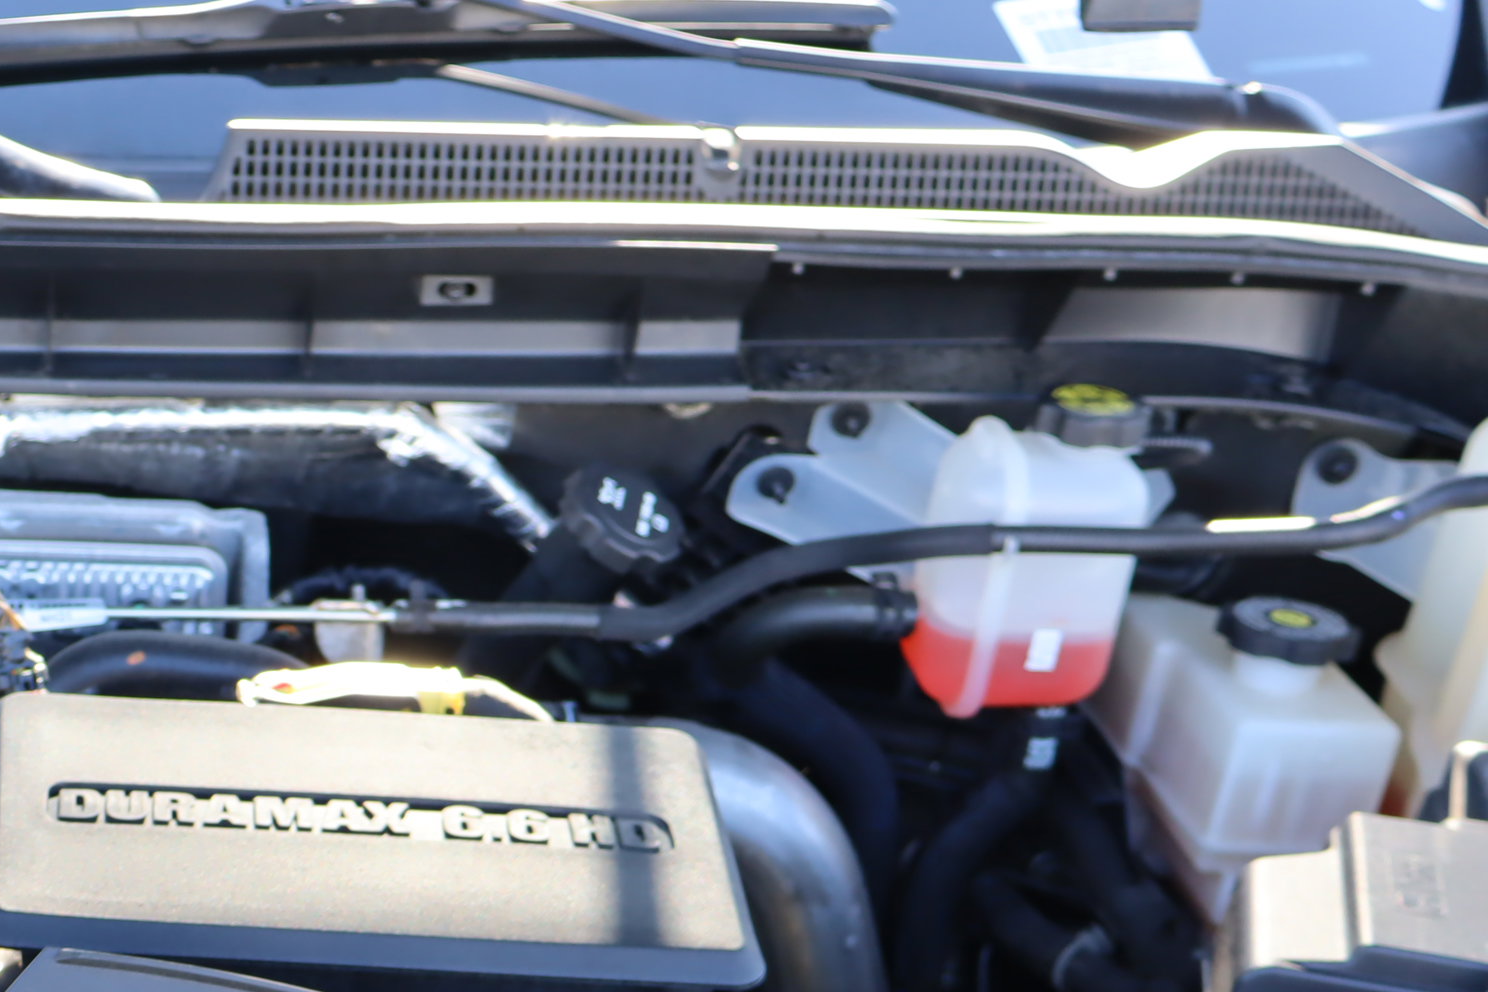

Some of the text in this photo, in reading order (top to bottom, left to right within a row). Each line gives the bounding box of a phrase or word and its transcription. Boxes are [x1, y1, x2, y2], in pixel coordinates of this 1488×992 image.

[57, 787, 663, 853] DURAMAX 6.6 HD
